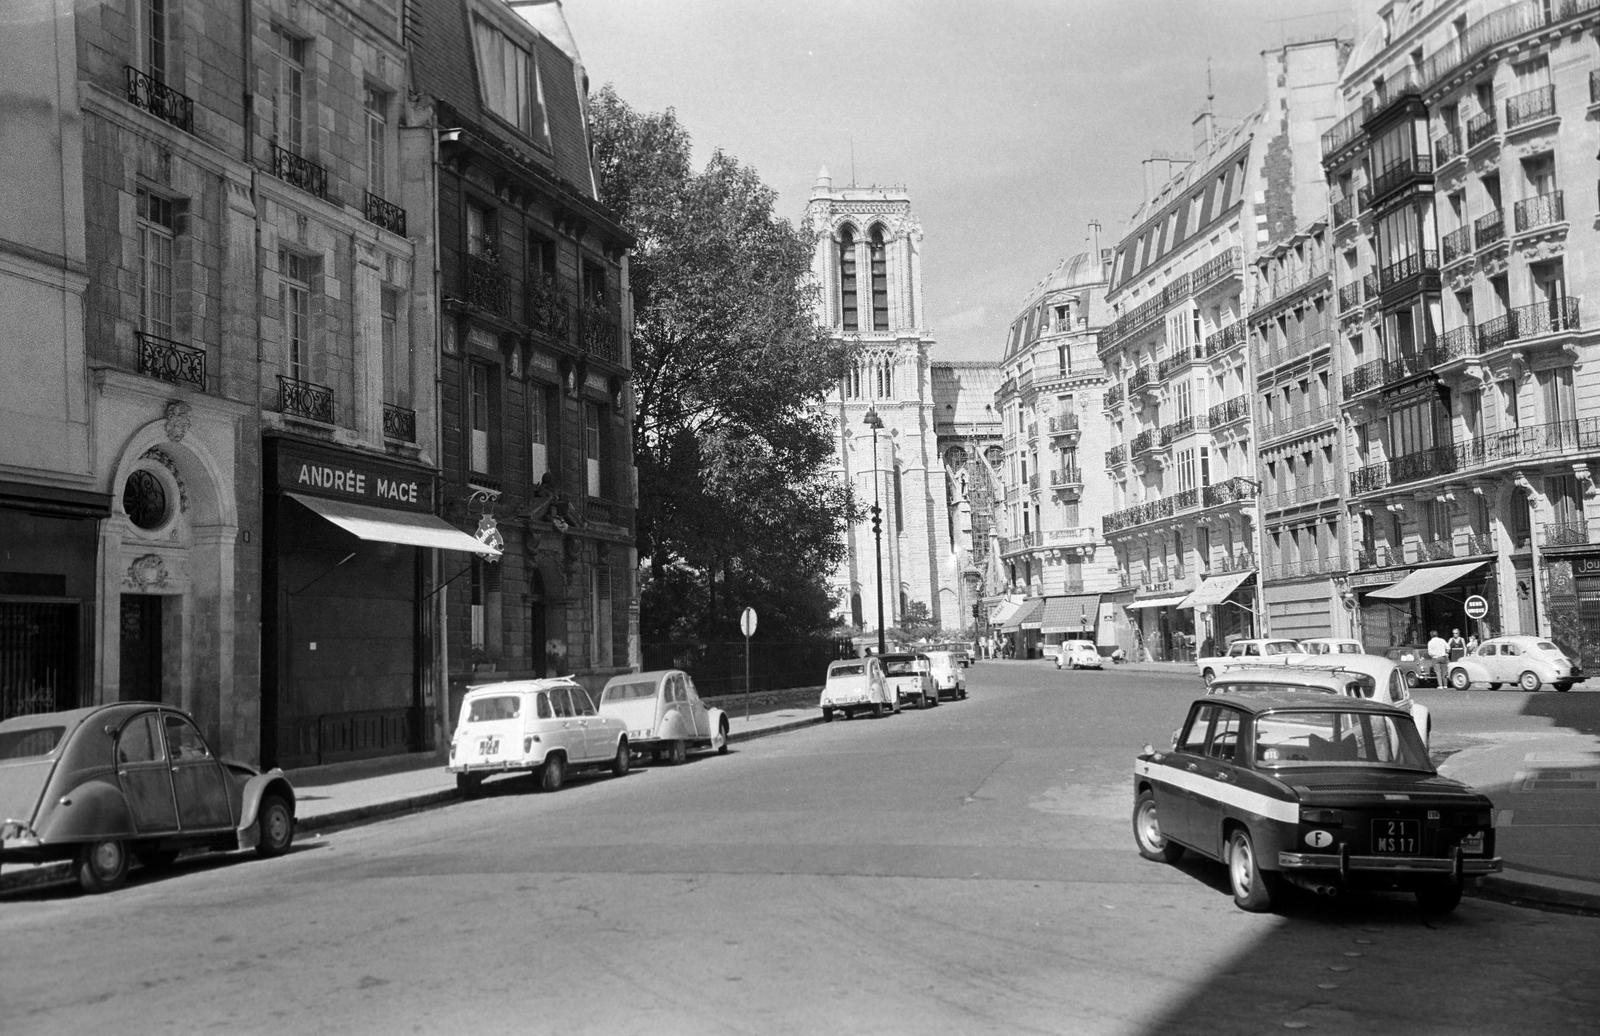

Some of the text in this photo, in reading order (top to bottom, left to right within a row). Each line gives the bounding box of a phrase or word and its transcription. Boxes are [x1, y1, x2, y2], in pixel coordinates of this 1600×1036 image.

[298, 464, 418, 503] ANDRÉE MACÉ
[1315, 832, 1322, 846] F
